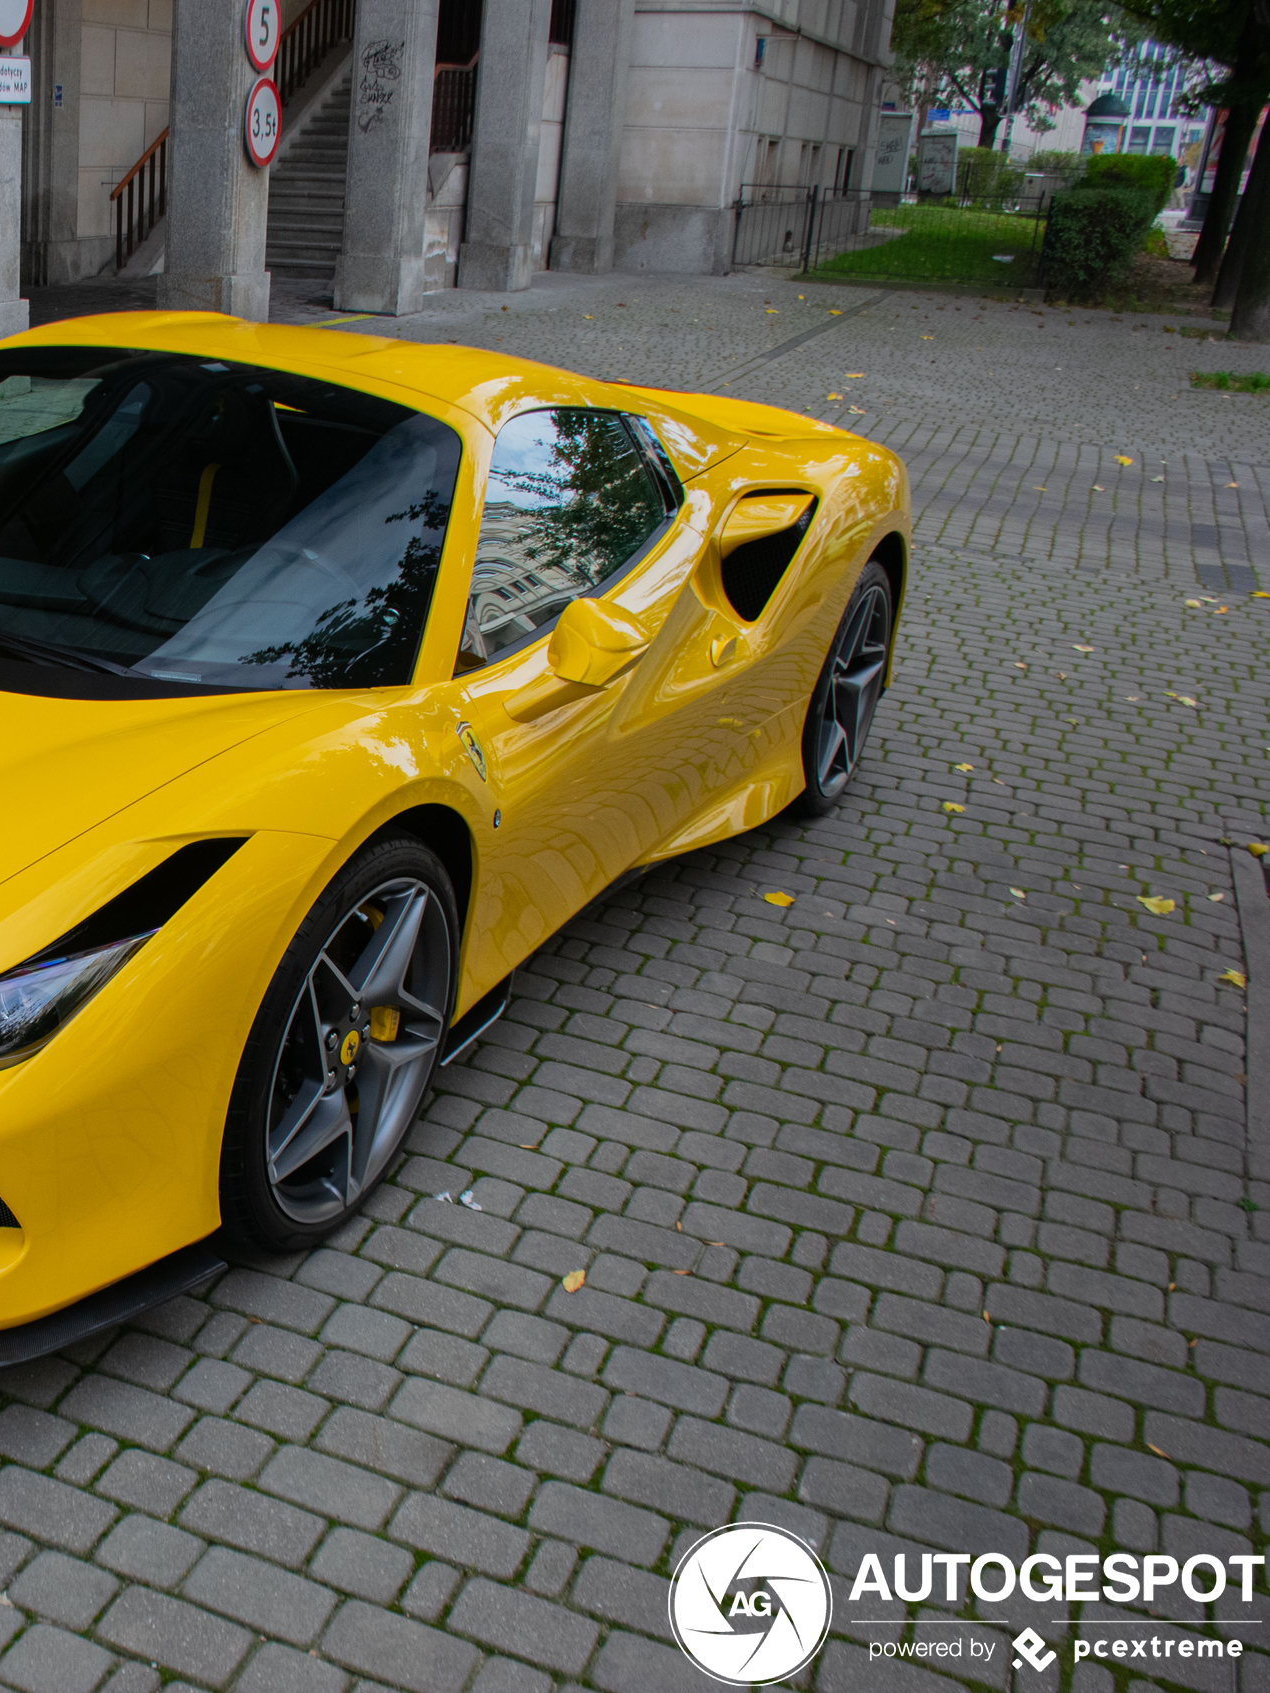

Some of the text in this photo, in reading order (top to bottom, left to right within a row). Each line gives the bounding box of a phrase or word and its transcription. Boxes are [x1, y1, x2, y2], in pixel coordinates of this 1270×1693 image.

[259, 6, 270, 47] 5
[0, 65, 22, 79] dotyczy
[13, 82, 28, 93] MAP
[252, 107, 276, 141] 3,5t
